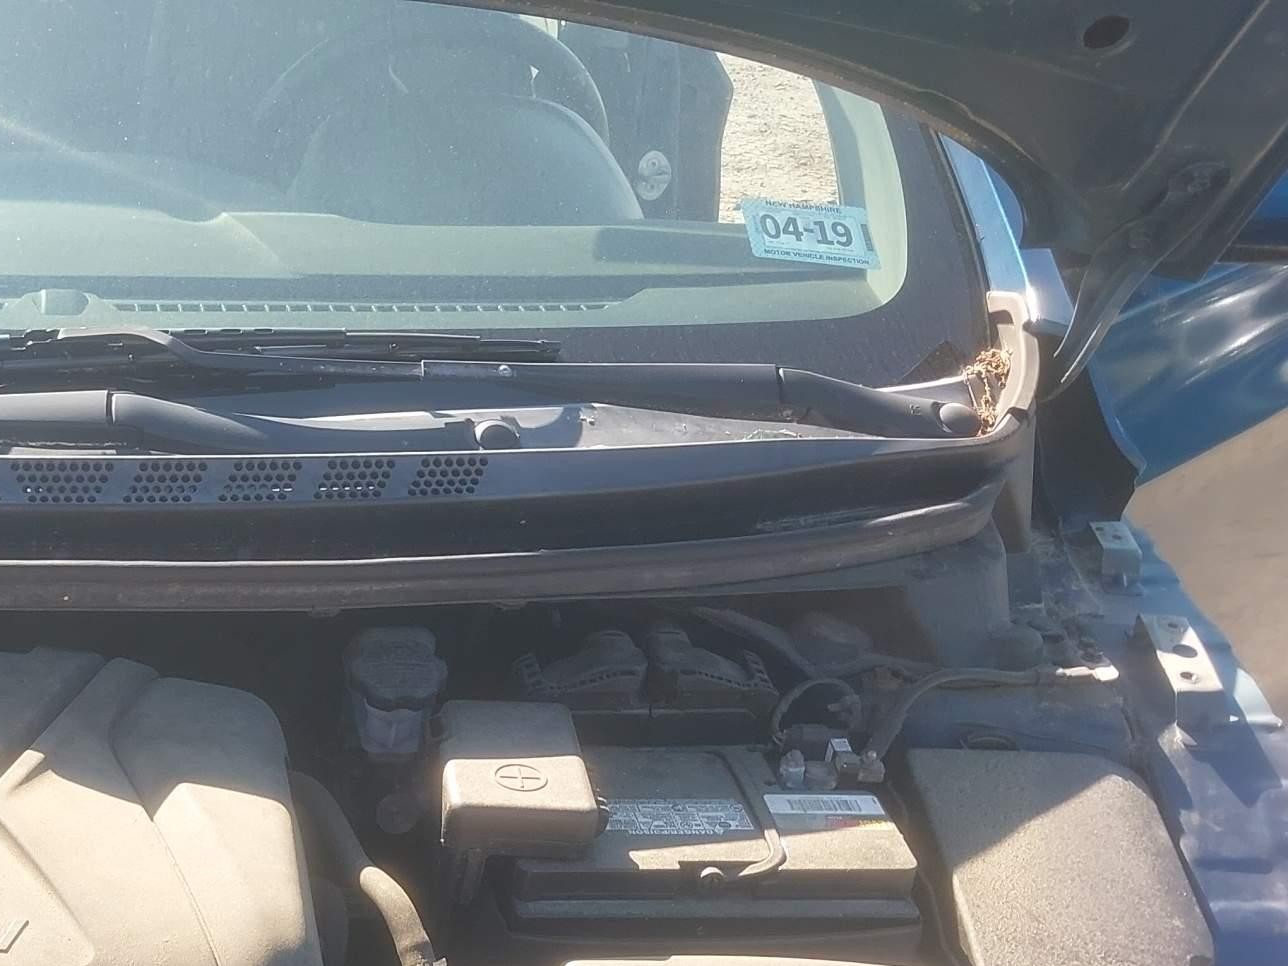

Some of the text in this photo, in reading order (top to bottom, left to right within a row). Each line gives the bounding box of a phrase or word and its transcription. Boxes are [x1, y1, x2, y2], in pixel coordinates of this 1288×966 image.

[759, 213, 854, 247] 04-19
[764, 249, 791, 257] MOTOR
[792, 252, 825, 260] VEHICLE
